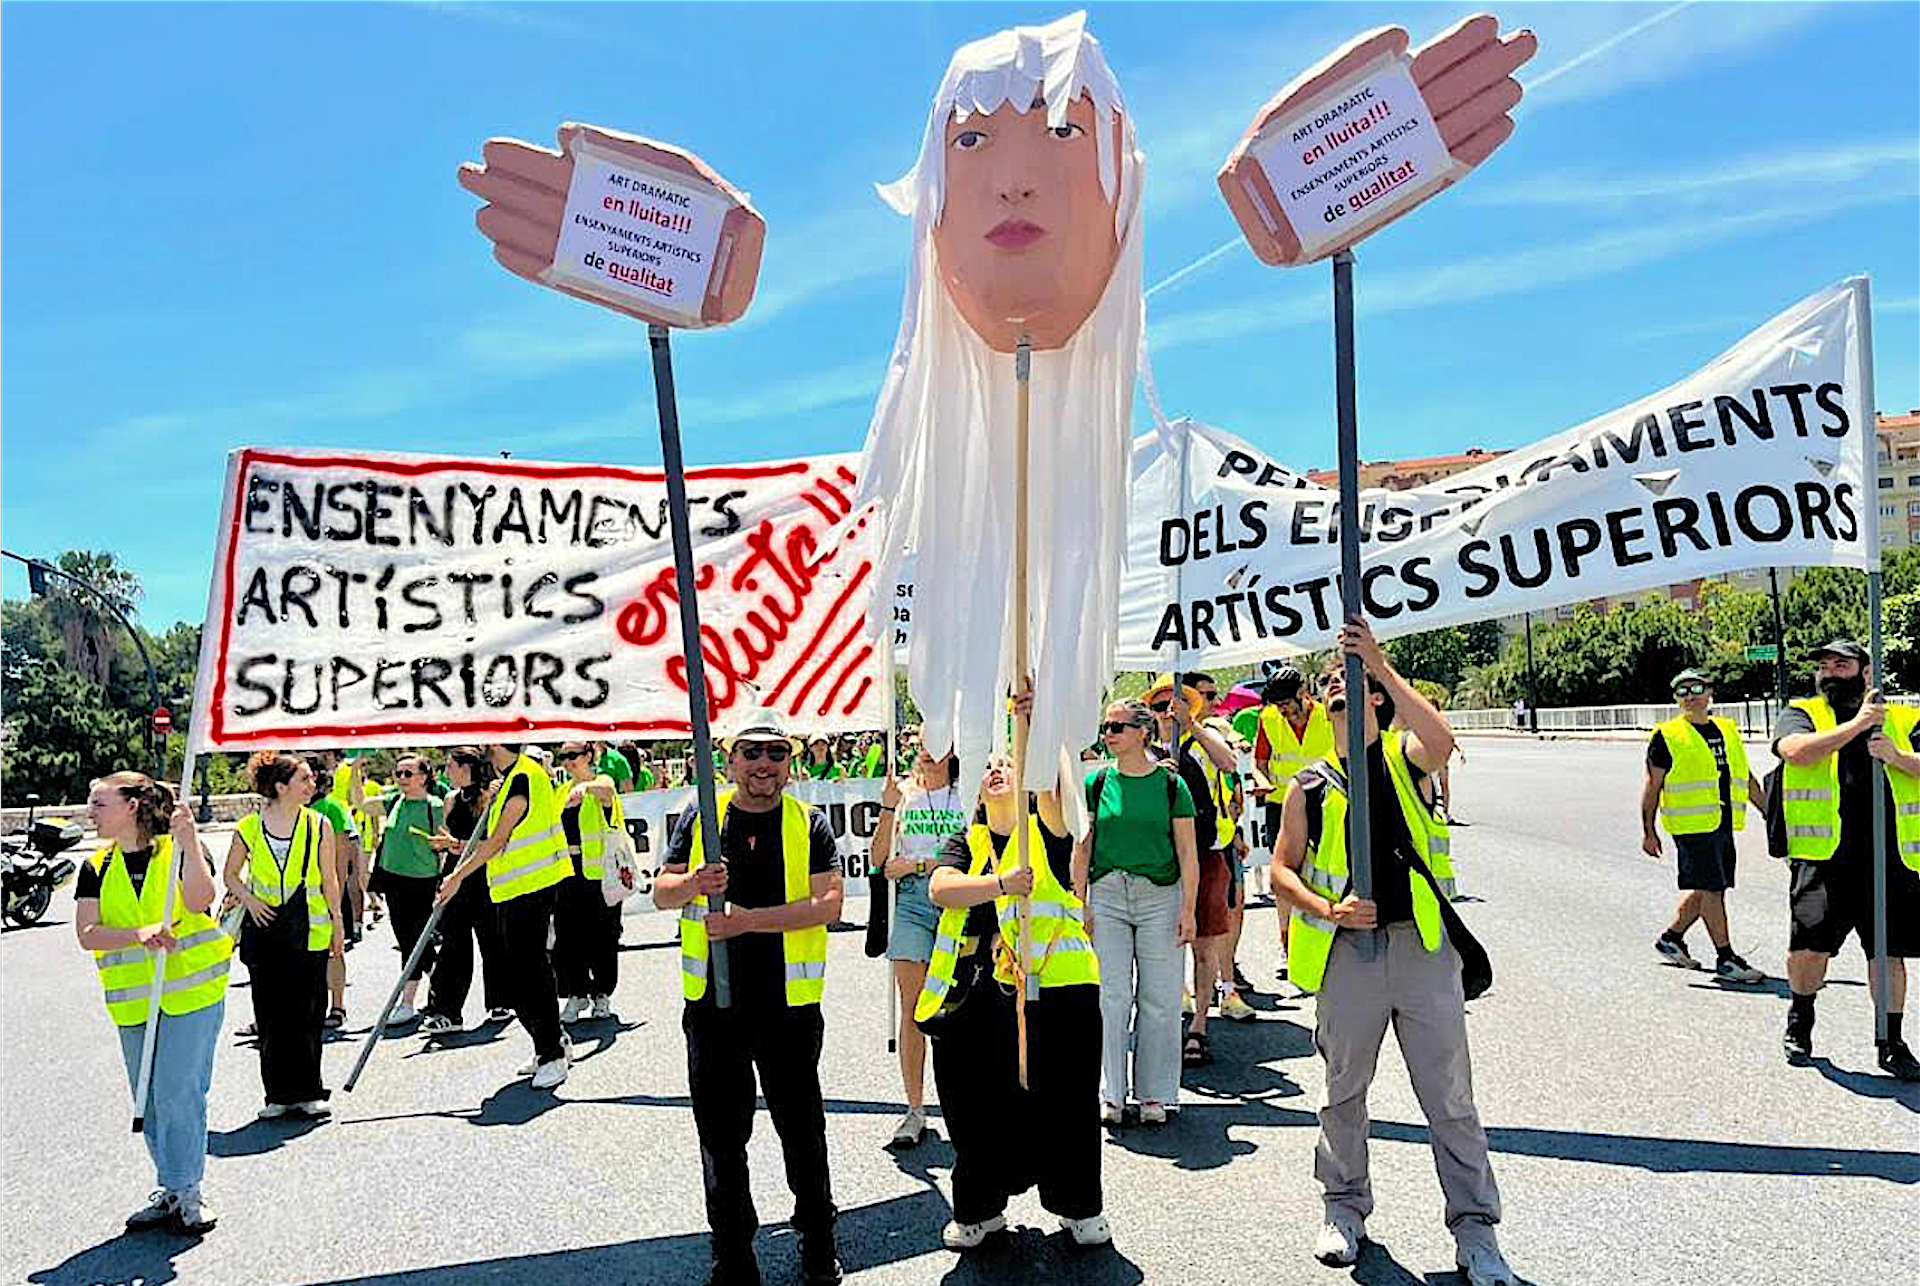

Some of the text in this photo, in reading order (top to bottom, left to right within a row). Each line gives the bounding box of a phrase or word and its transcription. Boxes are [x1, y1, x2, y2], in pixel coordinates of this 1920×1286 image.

[1292, 125, 1313, 143] ART
[1303, 100, 1391, 166] en lluita!!!
[608, 174, 630, 189] ART
[1291, 148, 1369, 201] ENSENYAMENTS
[1324, 160, 1415, 223] de qualitat
[1334, 155, 1389, 192] SUPERIORS
[575, 213, 651, 247] ENSENYAMENTS
[603, 195, 692, 234] en lluita!!!
[584, 252, 675, 294] de qualitat
[608, 241, 661, 266] SUPERIORS
[1159, 500, 1268, 566] DELS
[1152, 483, 1858, 651] ARTÍSTCS SUPERIORS
